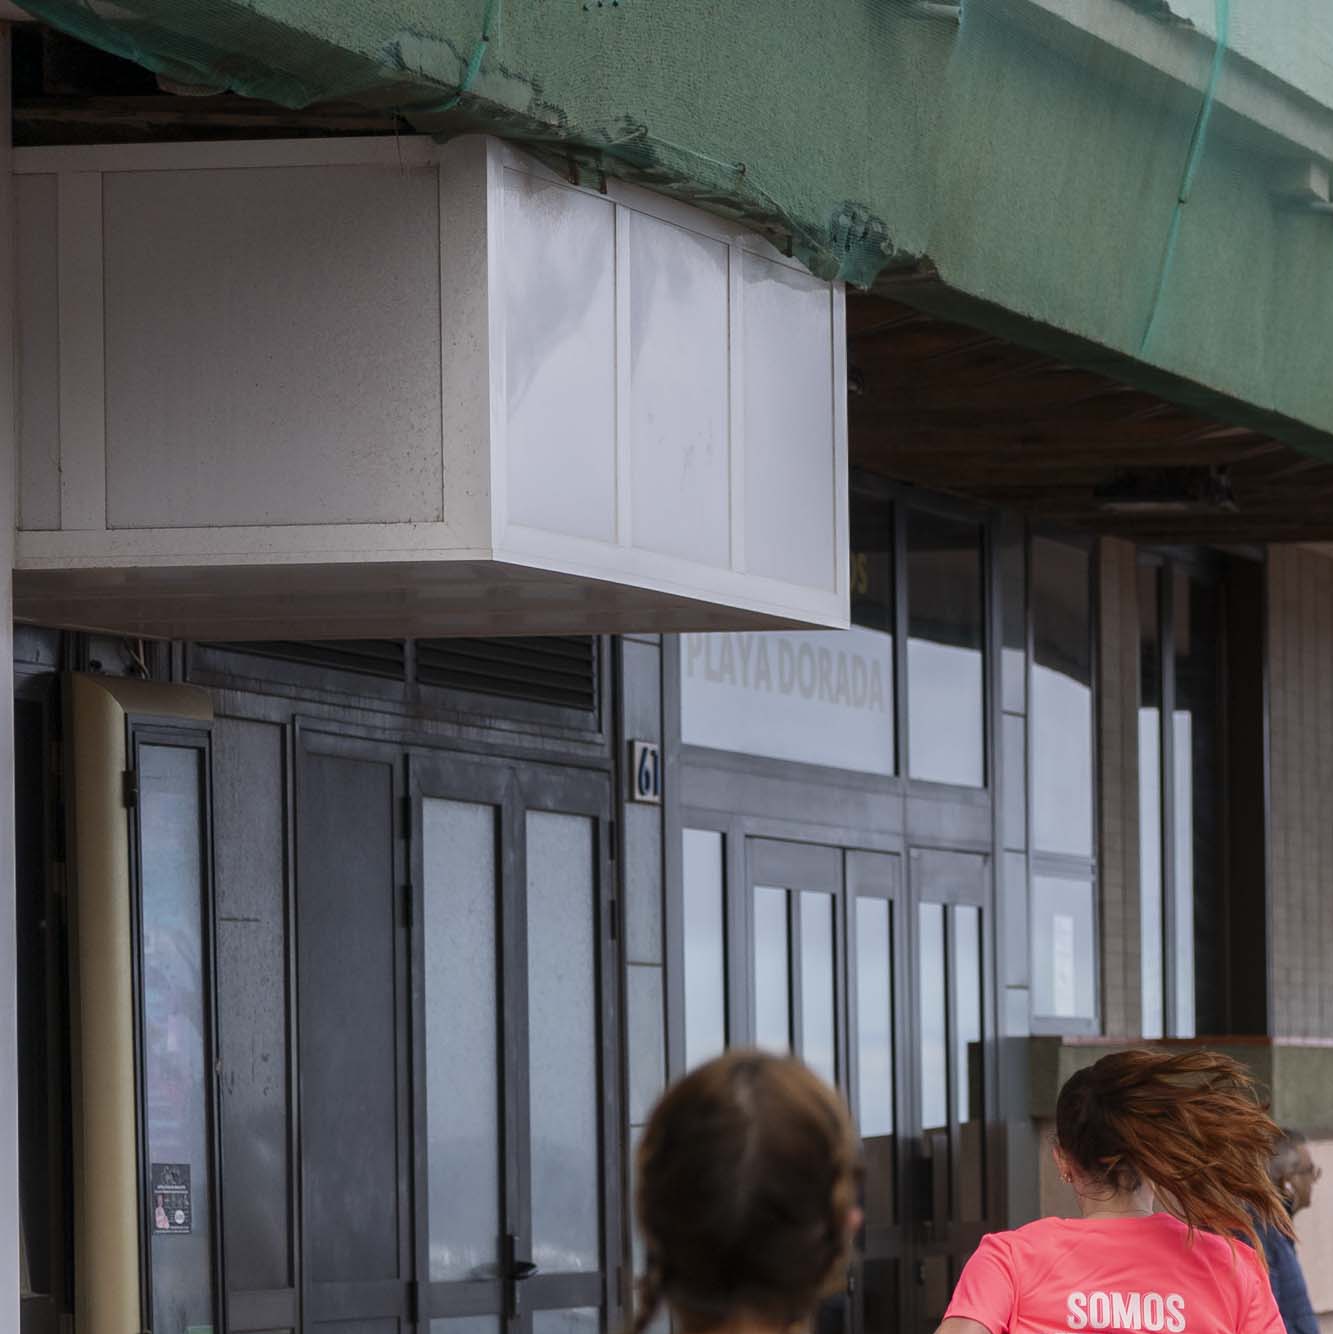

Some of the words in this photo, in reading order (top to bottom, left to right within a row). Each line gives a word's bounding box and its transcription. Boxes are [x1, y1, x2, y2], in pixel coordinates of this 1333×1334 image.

[687, 632, 772, 692] PLAYA
[778, 640, 884, 713] DORADA
[638, 746, 659, 797] 61
[1067, 1291, 1186, 1333] SOMOS
